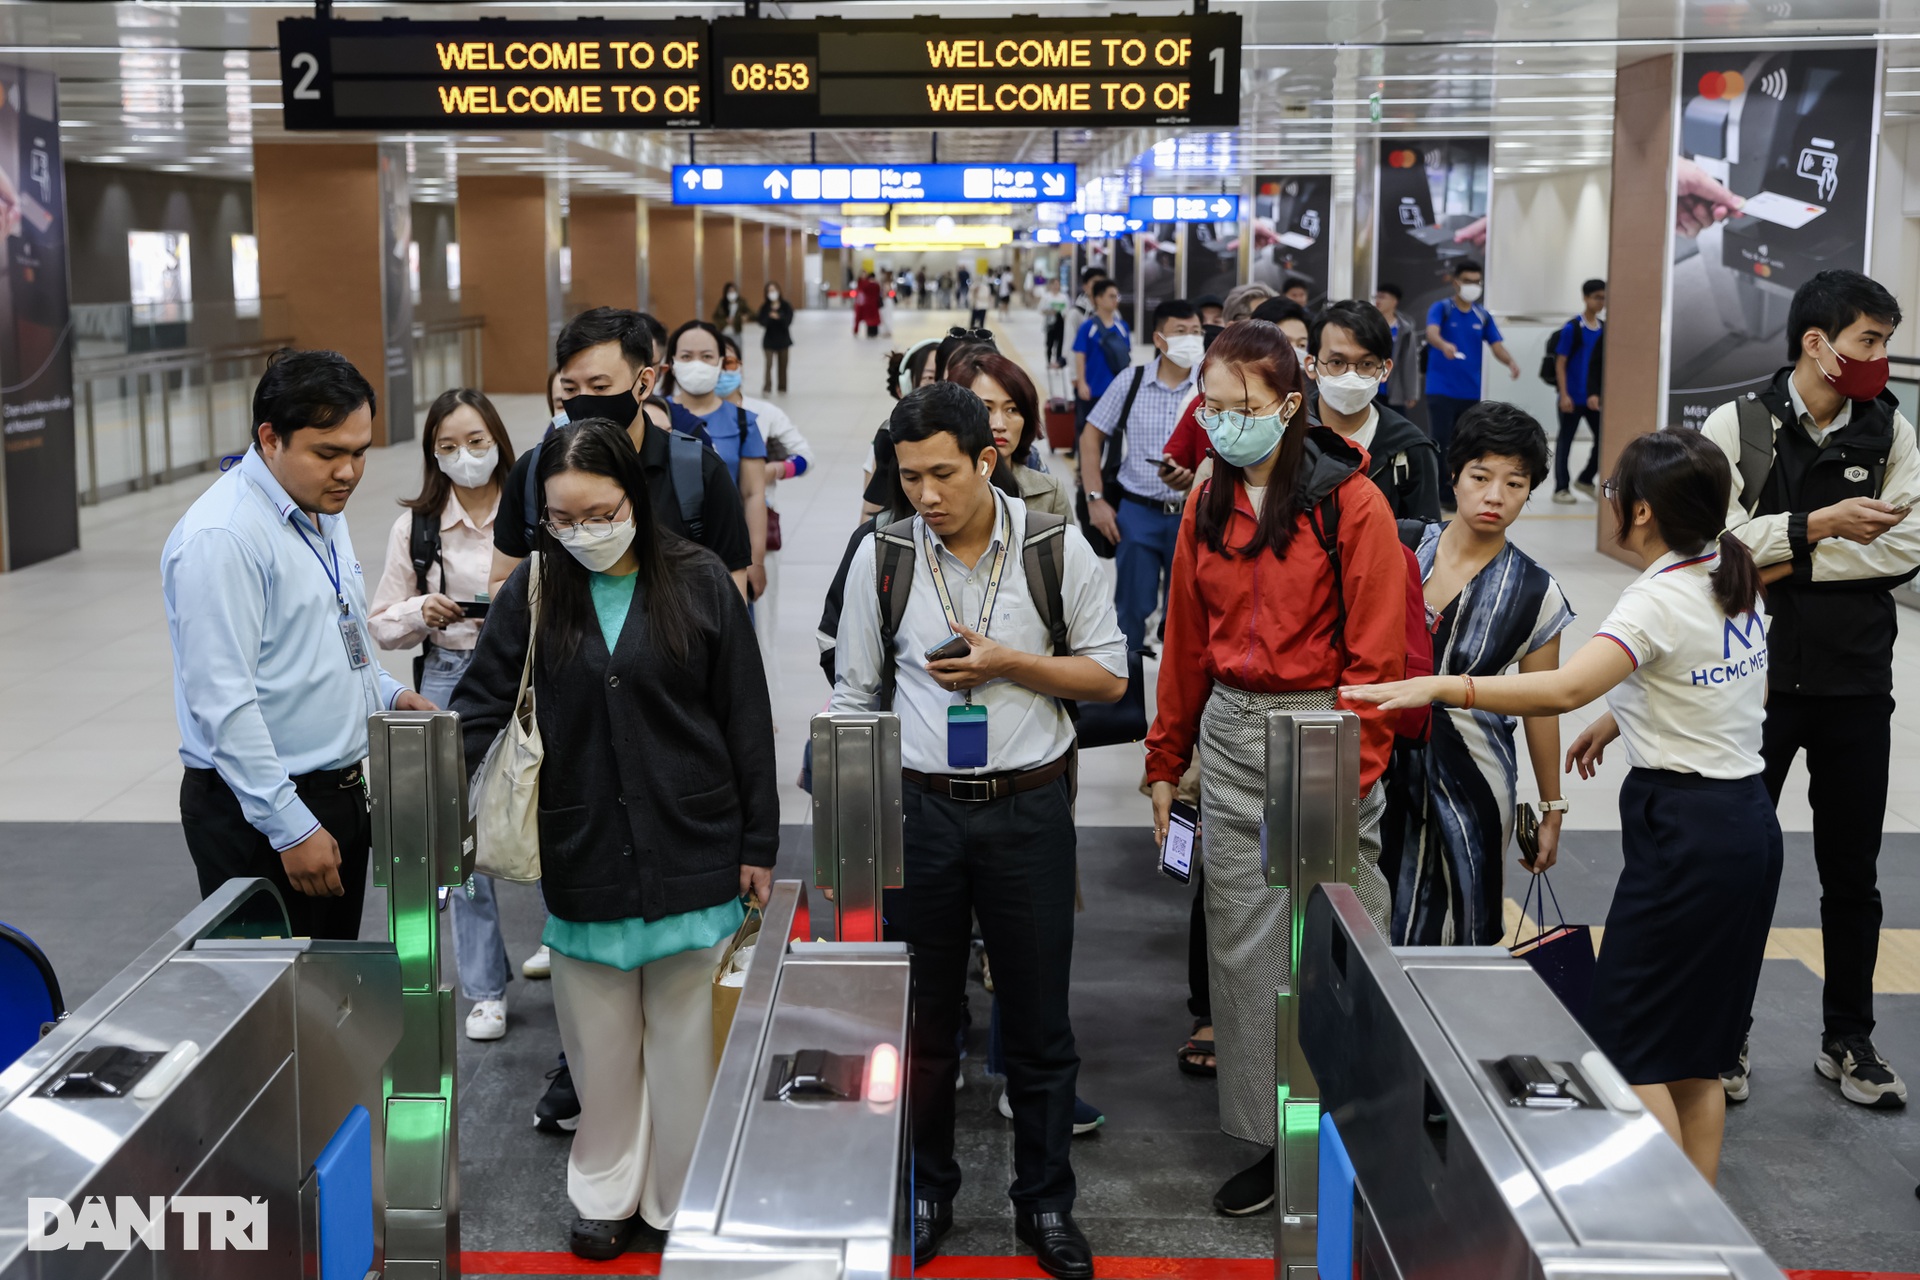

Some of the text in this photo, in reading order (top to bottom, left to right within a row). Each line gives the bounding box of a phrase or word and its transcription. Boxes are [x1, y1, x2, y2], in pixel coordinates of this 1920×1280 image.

[436, 42, 601, 70] WELCOME
[609, 42, 655, 69] TO
[926, 40, 1092, 68] WELCOME
[1101, 39, 1147, 66] TO
[291, 52, 320, 99] 2
[731, 63, 810, 91] 08:53
[1209, 47, 1225, 95] 1
[438, 86, 603, 114] WELCOME
[610, 86, 657, 113] TO
[926, 84, 1092, 111] WELCOME
[1100, 83, 1146, 110] TO
[1691, 660, 1748, 686] HCMC
